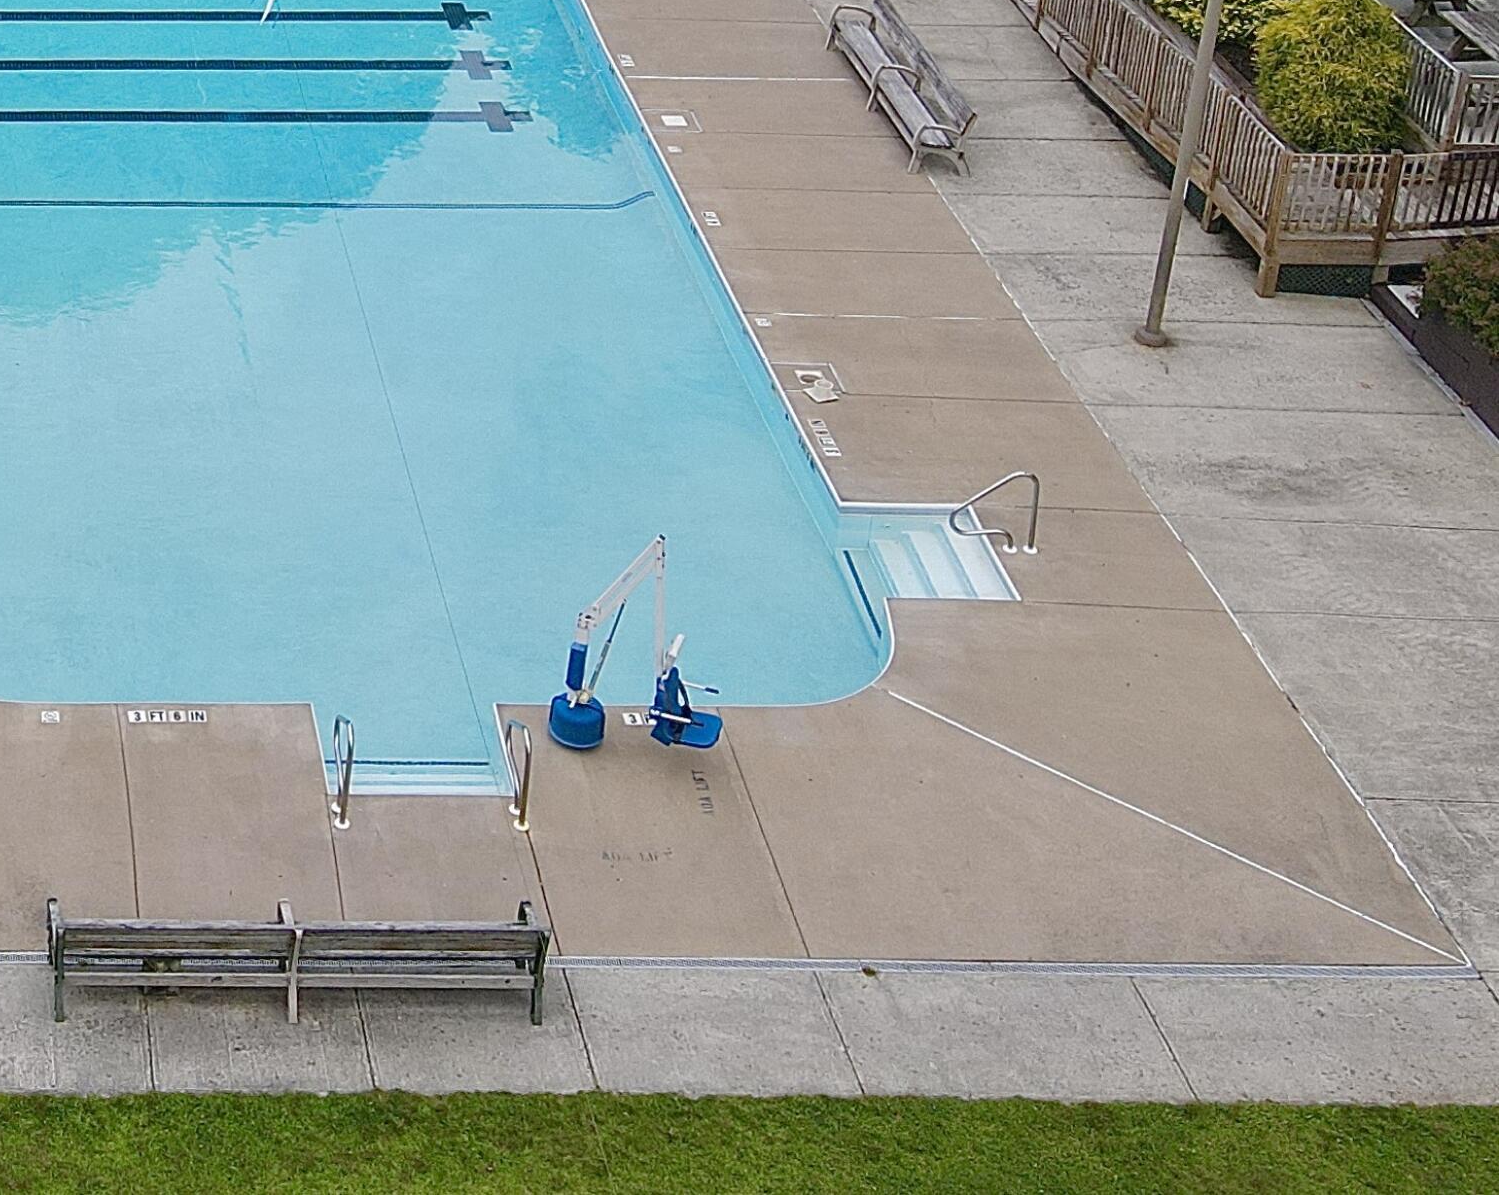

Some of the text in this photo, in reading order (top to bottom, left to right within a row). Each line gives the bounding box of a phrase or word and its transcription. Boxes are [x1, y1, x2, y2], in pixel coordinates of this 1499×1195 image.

[133, 711, 205, 721] 3 FT 6 IN
